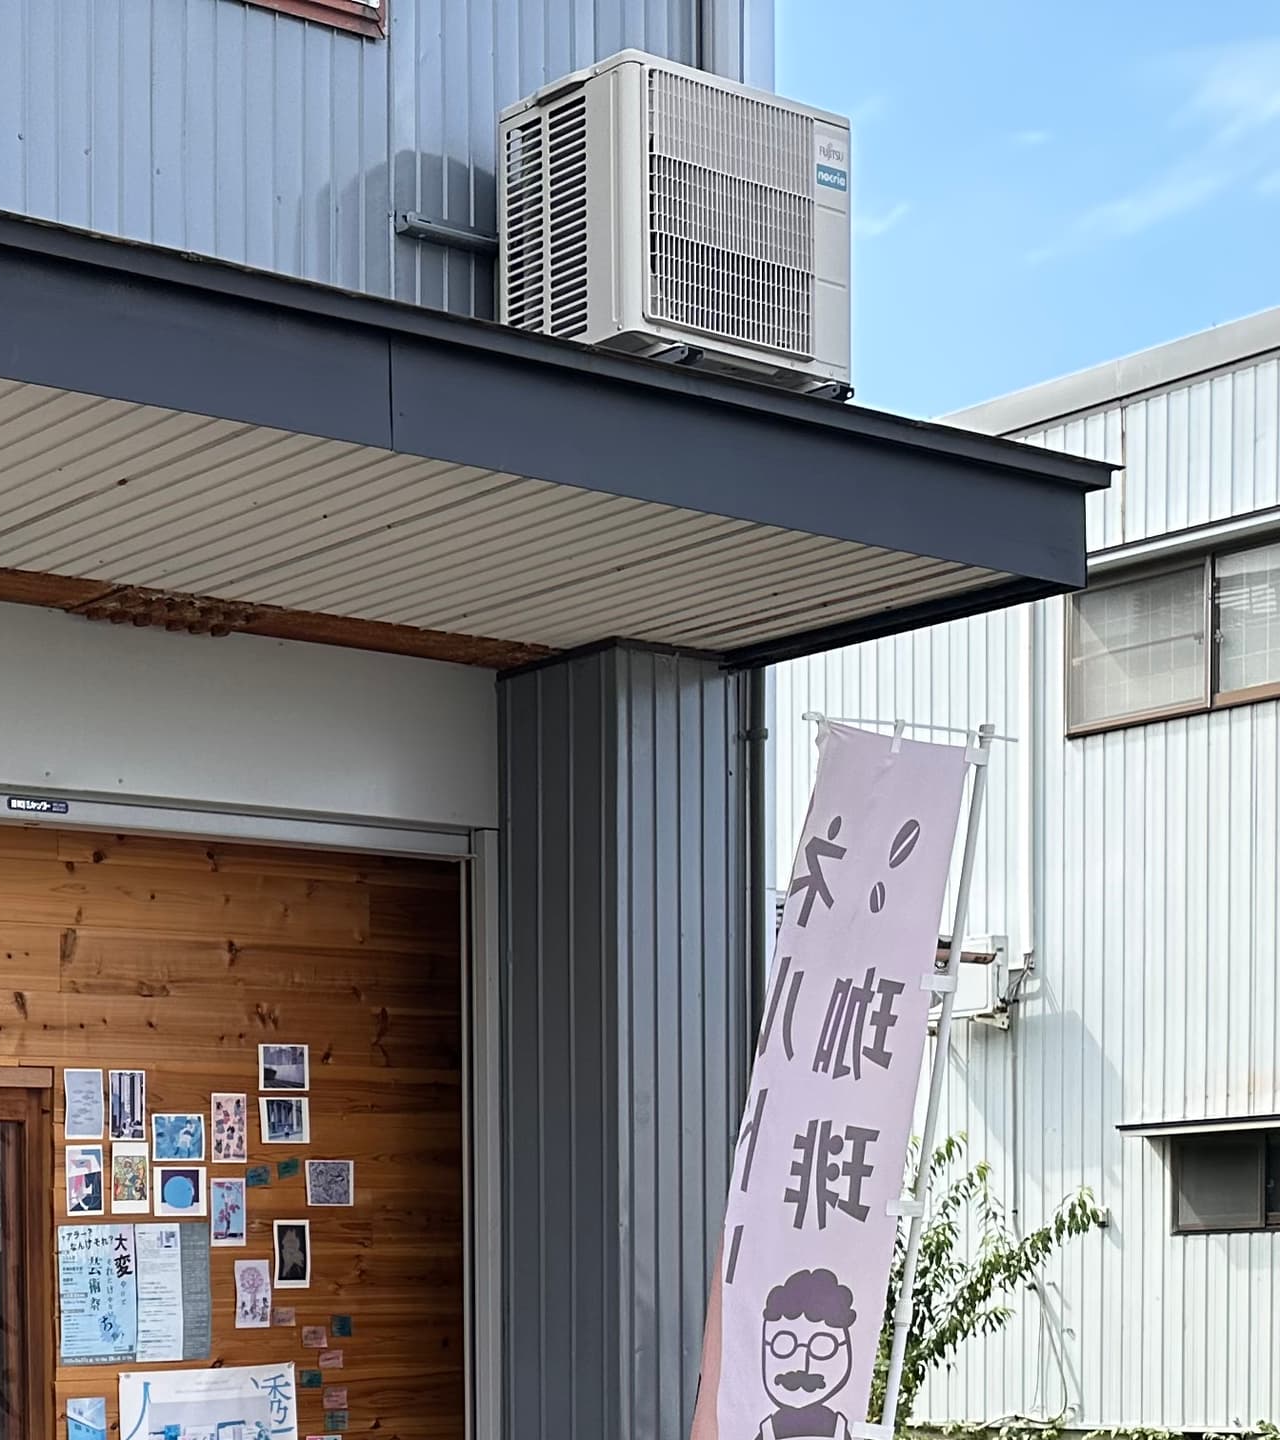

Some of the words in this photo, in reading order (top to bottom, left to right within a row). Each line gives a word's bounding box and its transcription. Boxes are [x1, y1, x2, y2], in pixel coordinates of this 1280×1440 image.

[819, 142, 844, 162] FUJITSU
[818, 171, 845, 186] nocria
[114, 1233, 133, 1279] 大変
